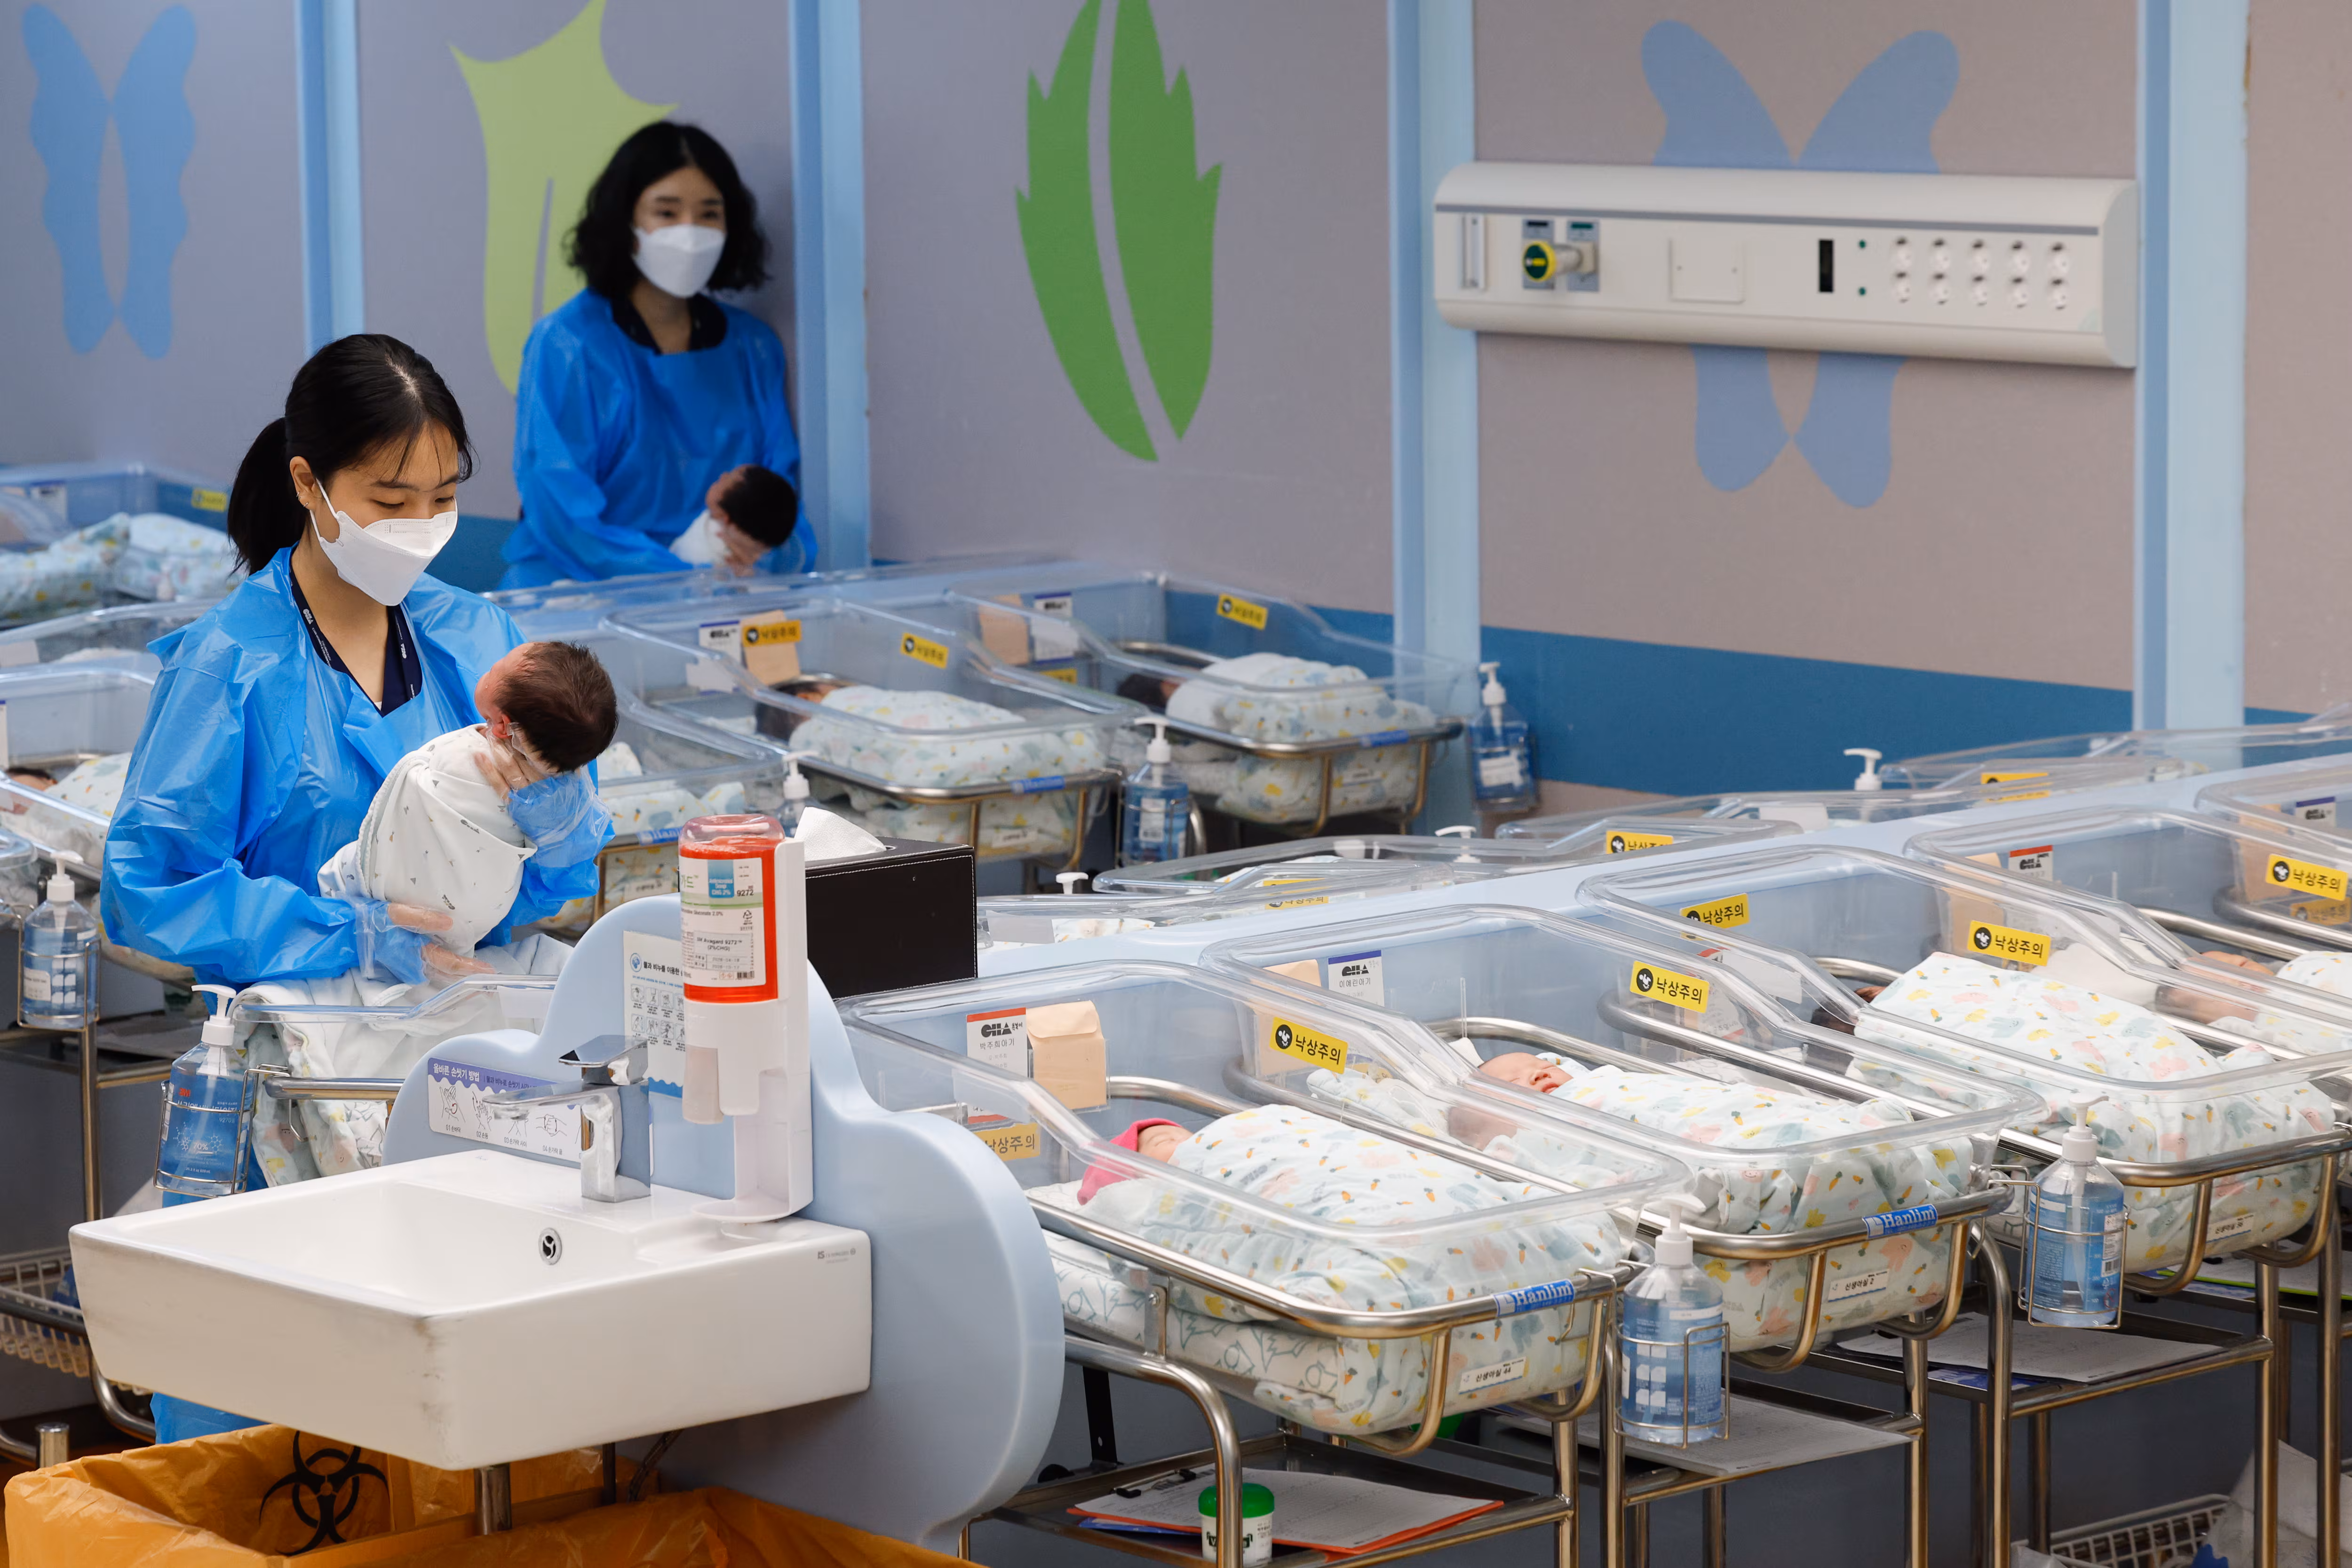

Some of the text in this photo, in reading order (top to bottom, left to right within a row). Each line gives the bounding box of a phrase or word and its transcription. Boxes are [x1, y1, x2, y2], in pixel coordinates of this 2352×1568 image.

[2293, 869, 2341, 893] 낙상주의
[1702, 903, 1744, 925] 낙상주의
[1994, 934, 2043, 958] 낙상주의
[667, 966, 680, 976] 이용한
[1342, 964, 1369, 977] CHA
[1656, 977, 1702, 1005] 낙상주의
[981, 1022, 1012, 1038] CHA
[1295, 1034, 1341, 1065] 낙상주의
[433, 1063, 450, 1076] 올바른
[451, 1066, 467, 1080] 손씻기
[469, 1070, 480, 1082] 방법
[179, 1087, 191, 1097] 3M
[509, 1138, 519, 1147] 손가락
[548, 1146, 558, 1155] 손가락
[1880, 1209, 1936, 1228] Hanlim
[1845, 1278, 1868, 1291] 신생아실
[1512, 1284, 1573, 1306] Hanlim
[1476, 1369, 1502, 1383] 신생아실
